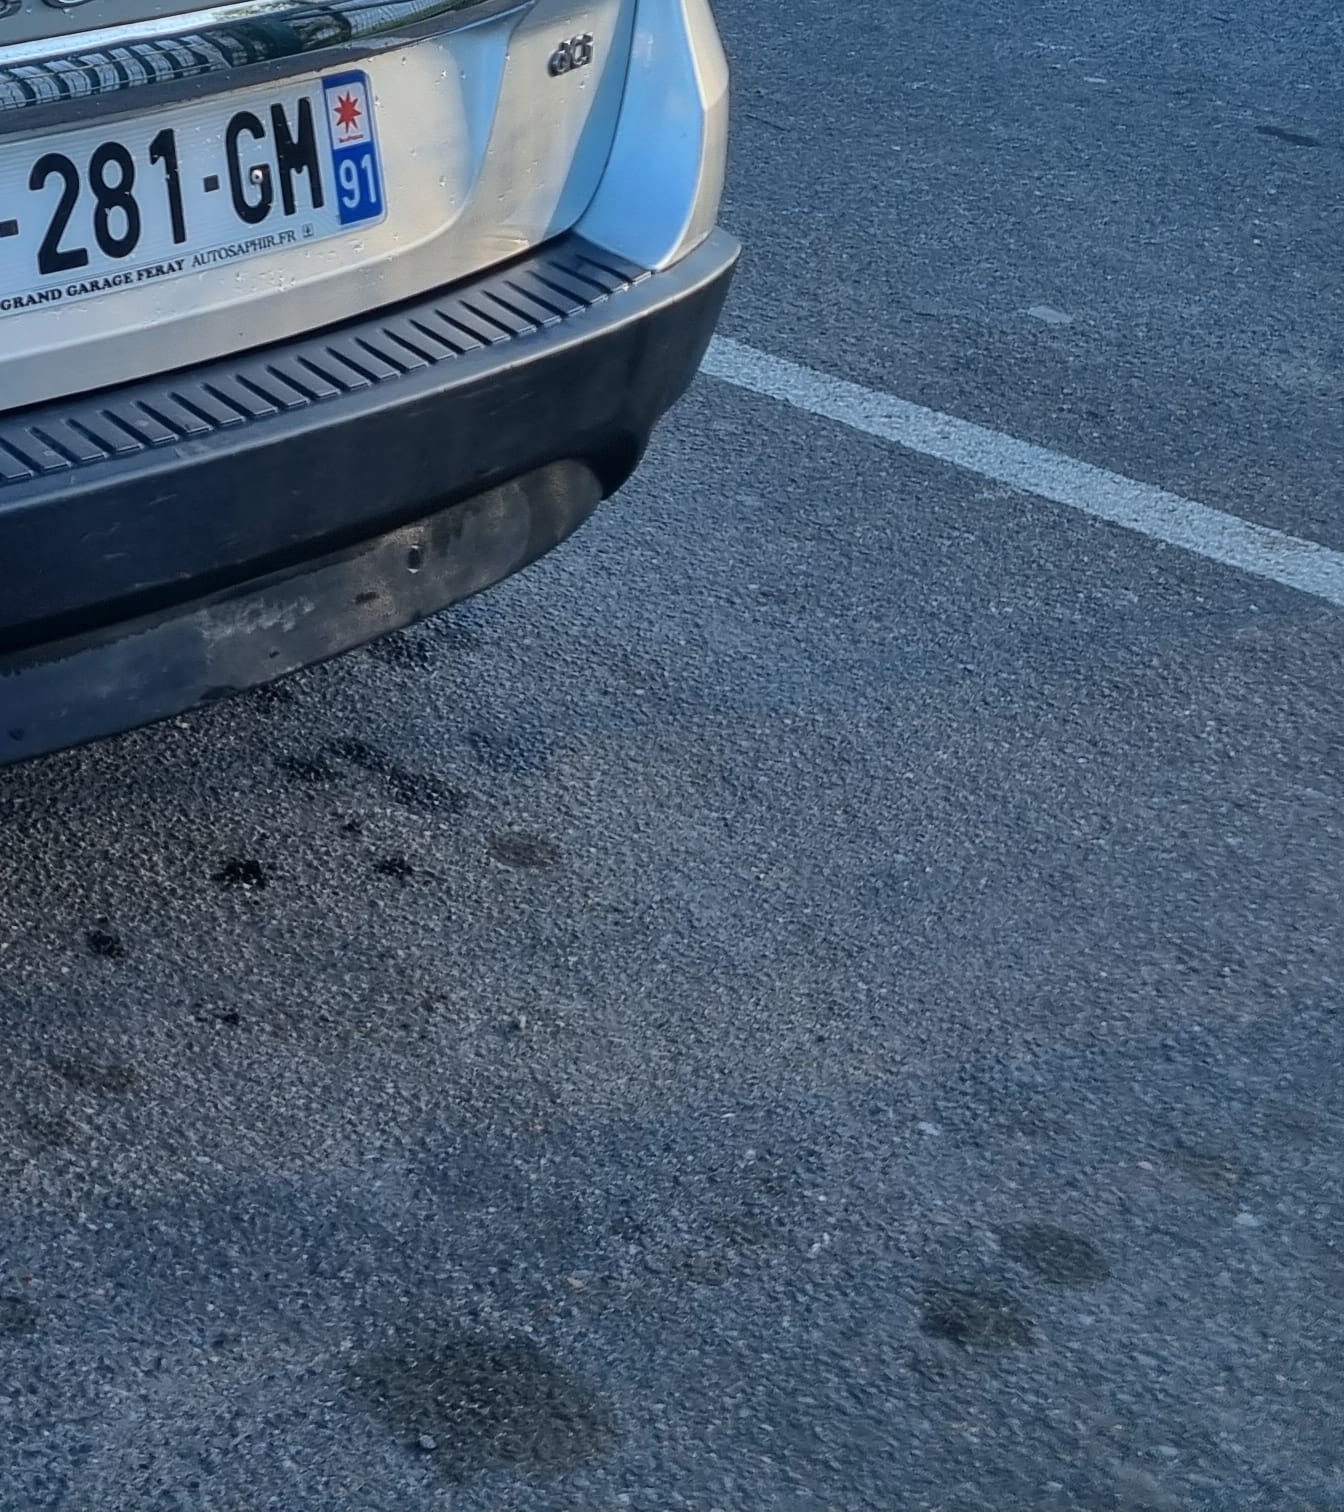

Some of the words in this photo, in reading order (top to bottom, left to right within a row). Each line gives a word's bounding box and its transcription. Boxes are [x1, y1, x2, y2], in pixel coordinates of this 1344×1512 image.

[339, 153, 377, 208] 91
[0, 288, 62, 311] GRAND
[66, 272, 133, 297] GARAGE
[137, 258, 185, 282] FERAY
[192, 229, 297, 268] AUTOSAPHIR.FR
